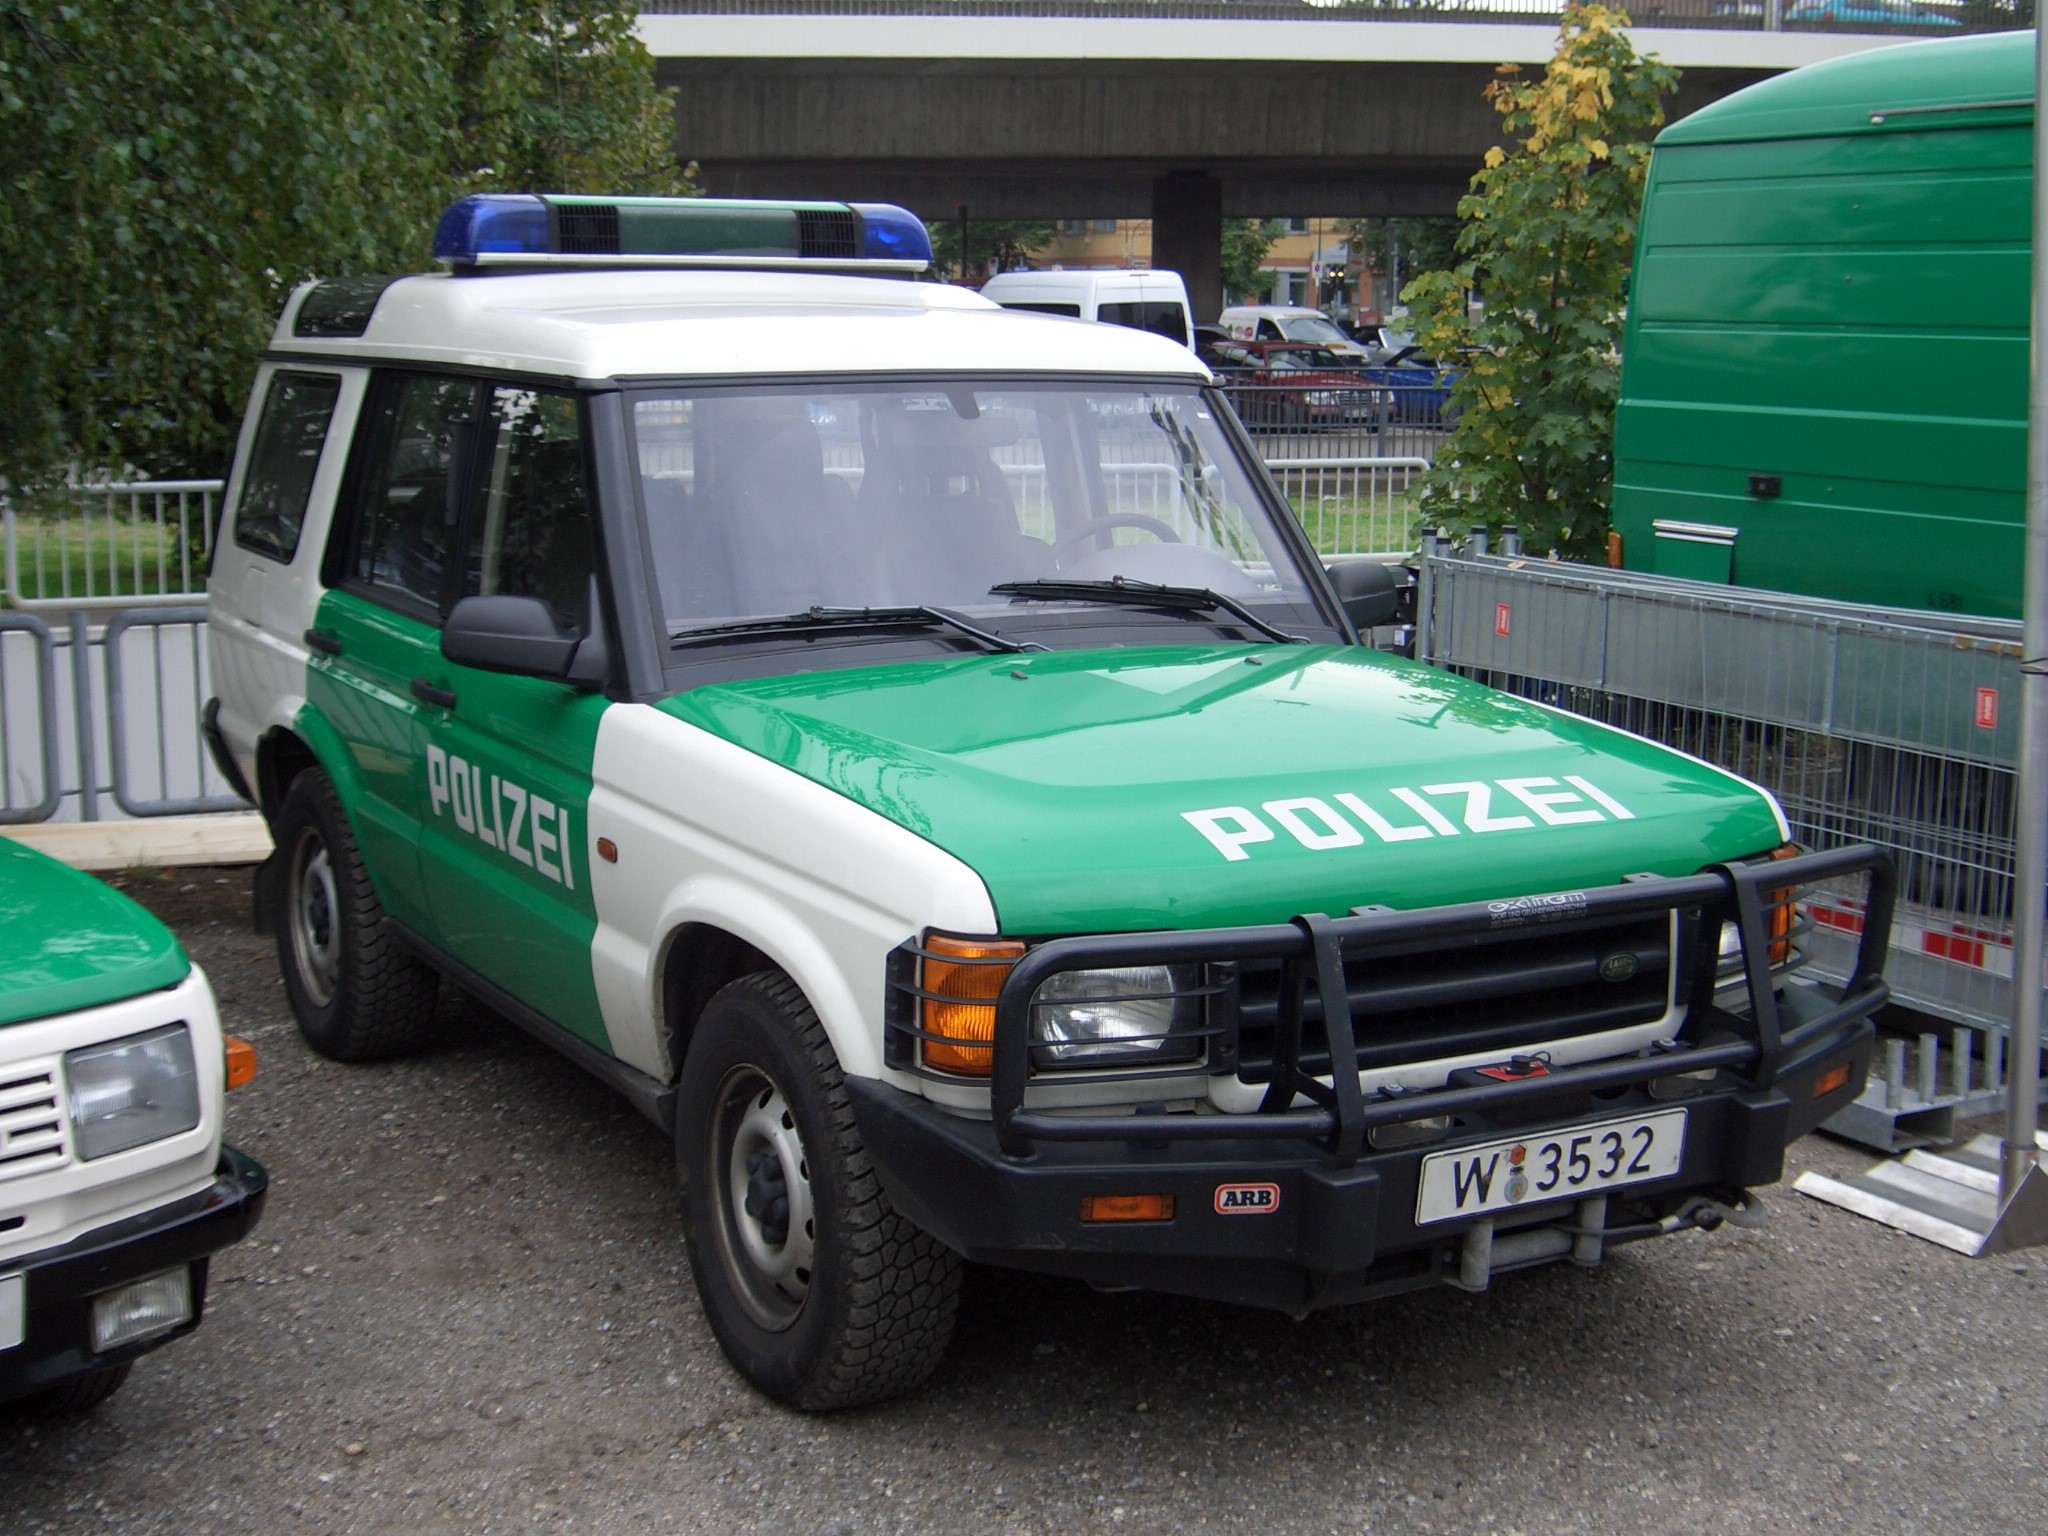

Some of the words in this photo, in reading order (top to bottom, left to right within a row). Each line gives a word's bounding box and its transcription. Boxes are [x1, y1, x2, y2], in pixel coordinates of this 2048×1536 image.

[427, 743, 575, 891] POLIZEI
[1181, 775, 1635, 861] POLIZEI
[1223, 1190, 1272, 1207] ARB
[1453, 1152, 1500, 1208] W
[1536, 1125, 1654, 1191] 3532
